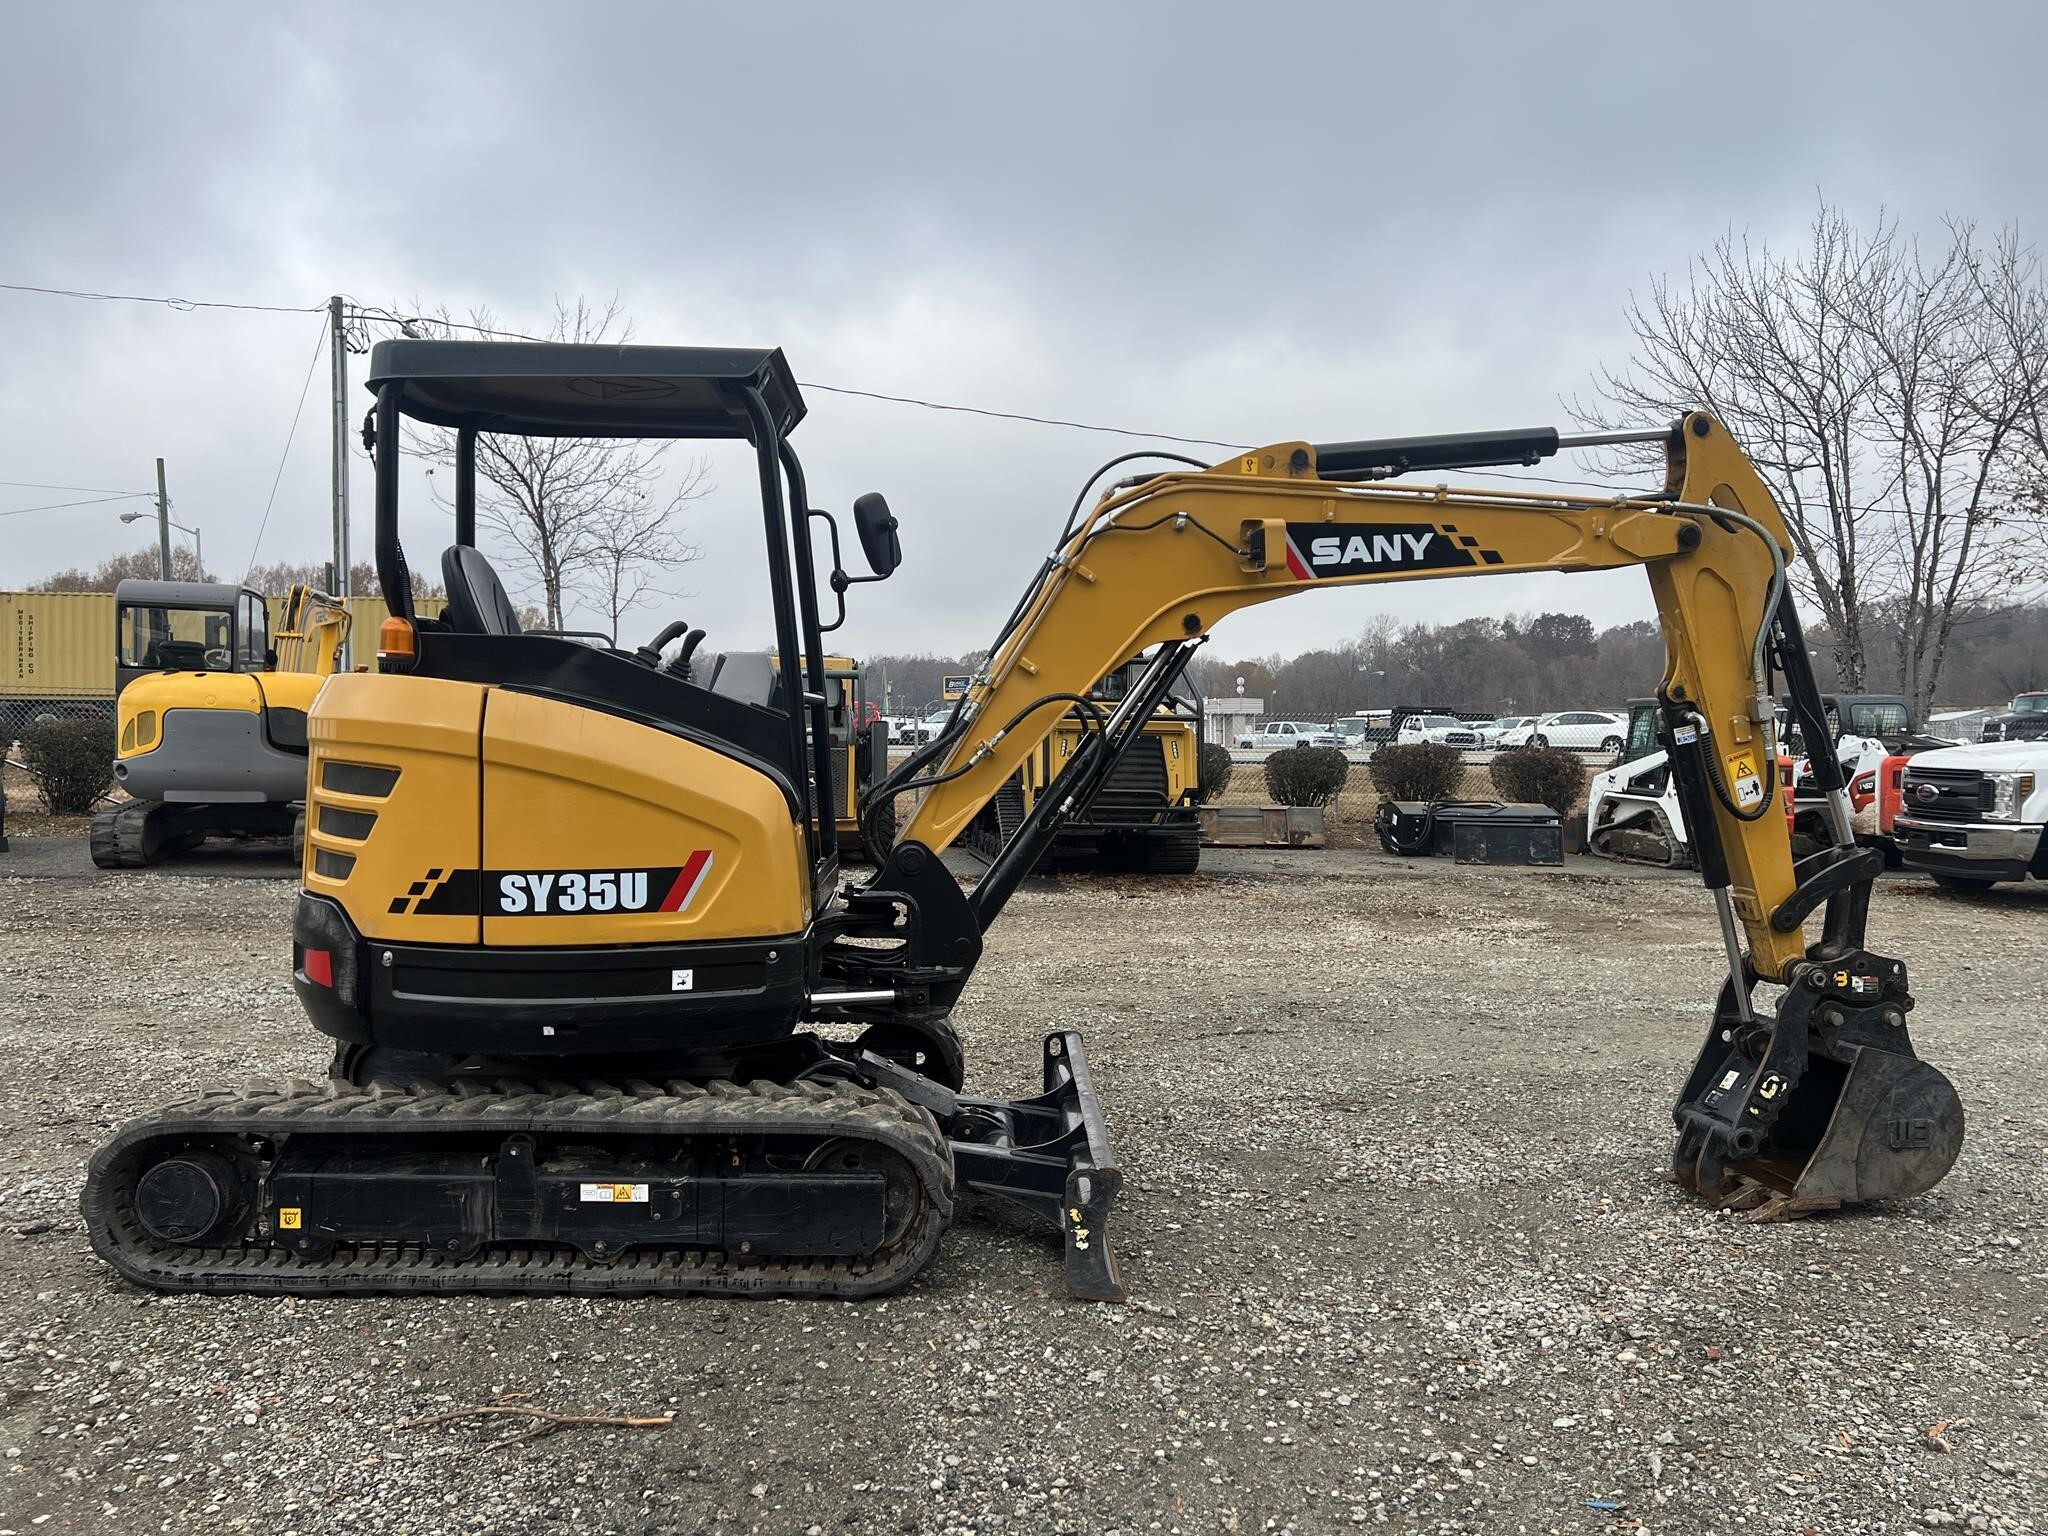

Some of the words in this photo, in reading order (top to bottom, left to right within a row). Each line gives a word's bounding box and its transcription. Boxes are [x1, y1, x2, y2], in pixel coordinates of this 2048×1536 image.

[1311, 532, 1434, 566] SANY
[28, 663, 34, 674] CO
[499, 872, 648, 912] SY35U
